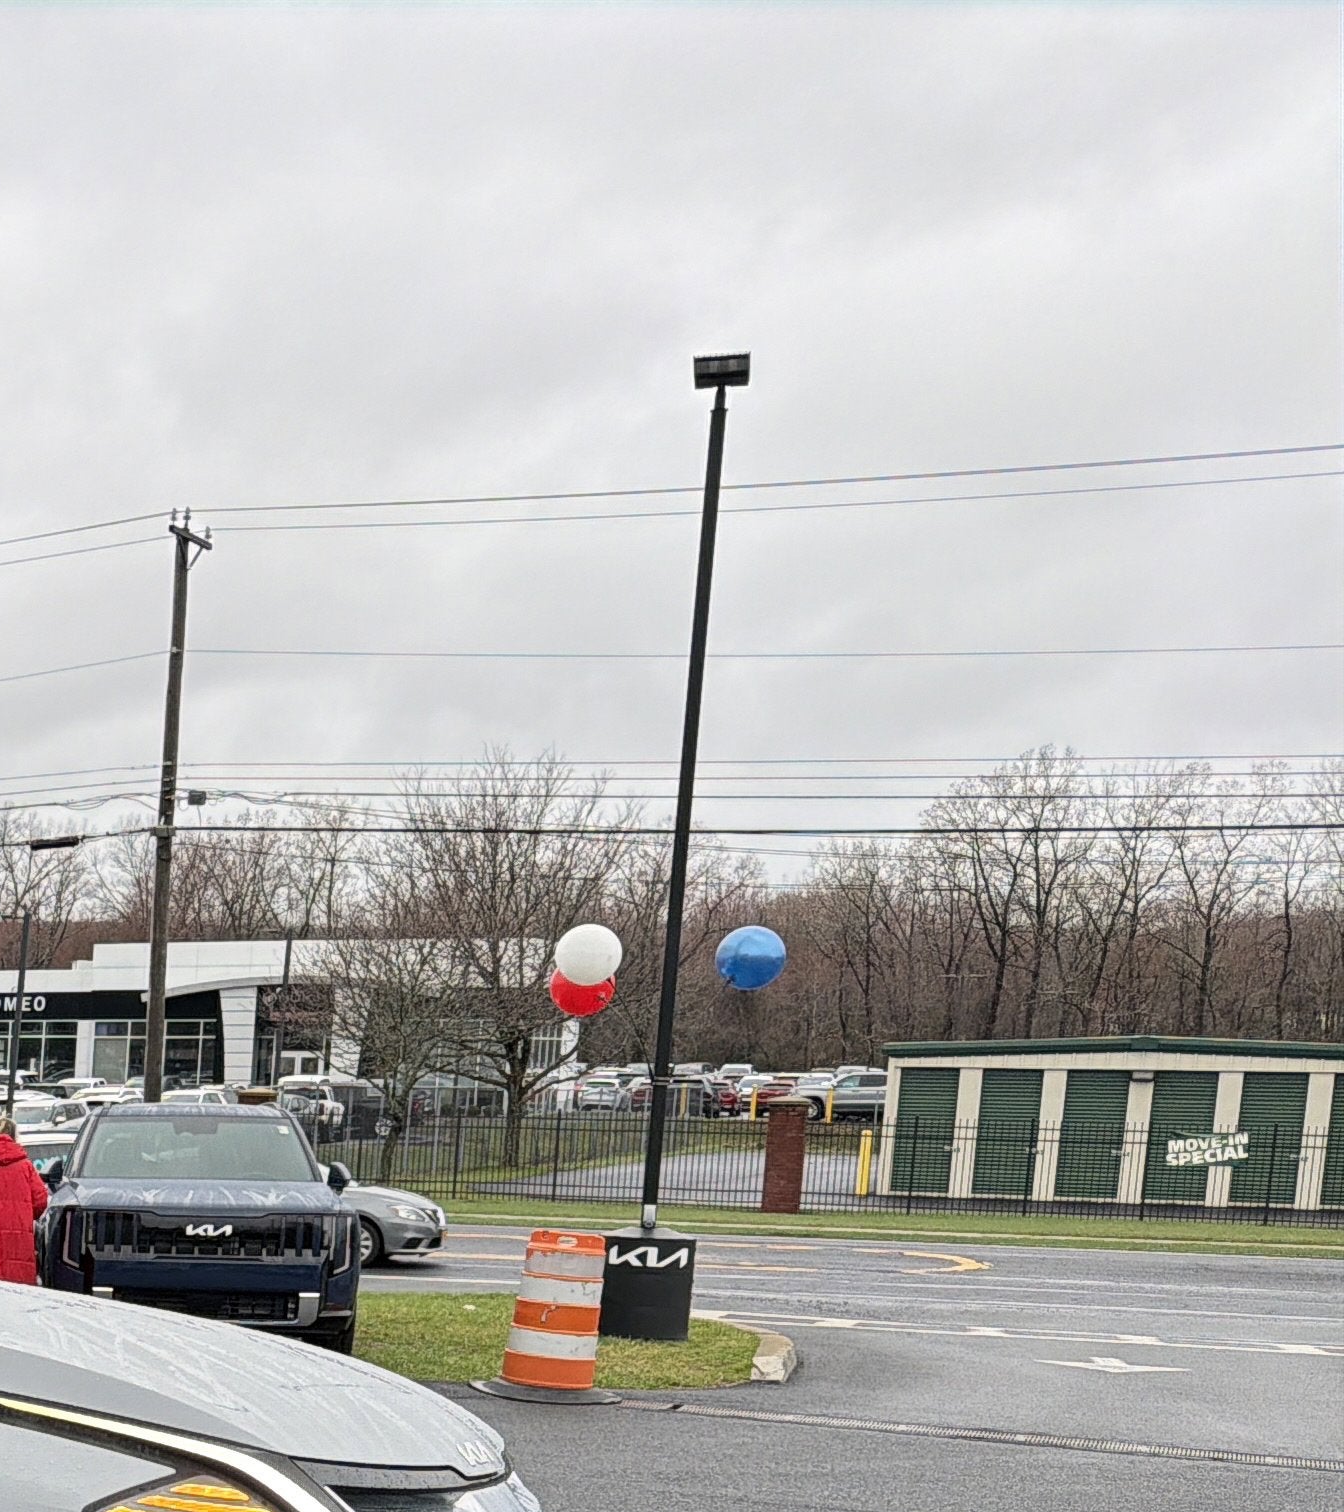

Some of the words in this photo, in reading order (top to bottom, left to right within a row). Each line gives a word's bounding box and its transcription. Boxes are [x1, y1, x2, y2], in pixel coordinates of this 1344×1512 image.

[1167, 1132, 1249, 1153] MOVE-IN
[1165, 1145, 1249, 1166] SPECIAL
[185, 1223, 233, 1237] KIA
[608, 1244, 689, 1269] KIA
